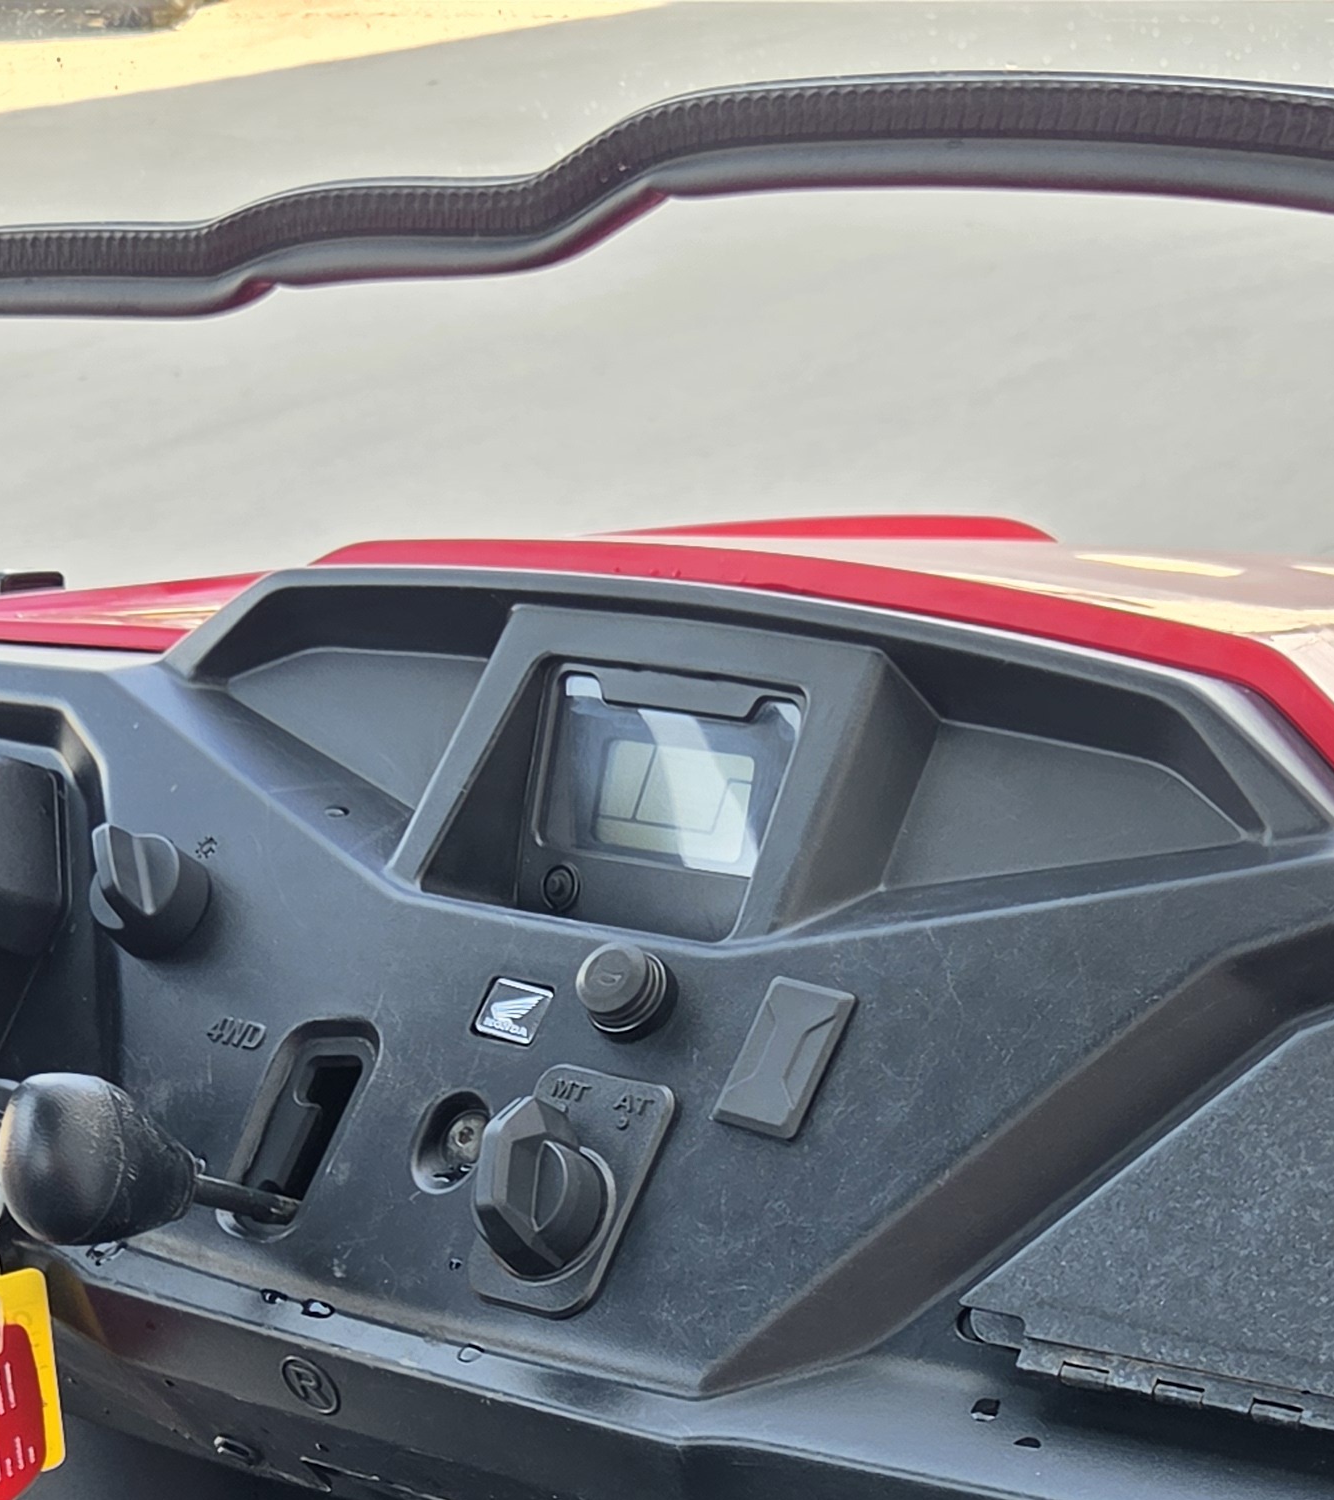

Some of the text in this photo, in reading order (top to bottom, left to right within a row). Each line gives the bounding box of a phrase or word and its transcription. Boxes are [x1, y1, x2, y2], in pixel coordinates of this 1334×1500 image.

[206, 1016, 267, 1051] 4WD
[551, 1078, 592, 1102] MT
[613, 1094, 655, 1116] AT
